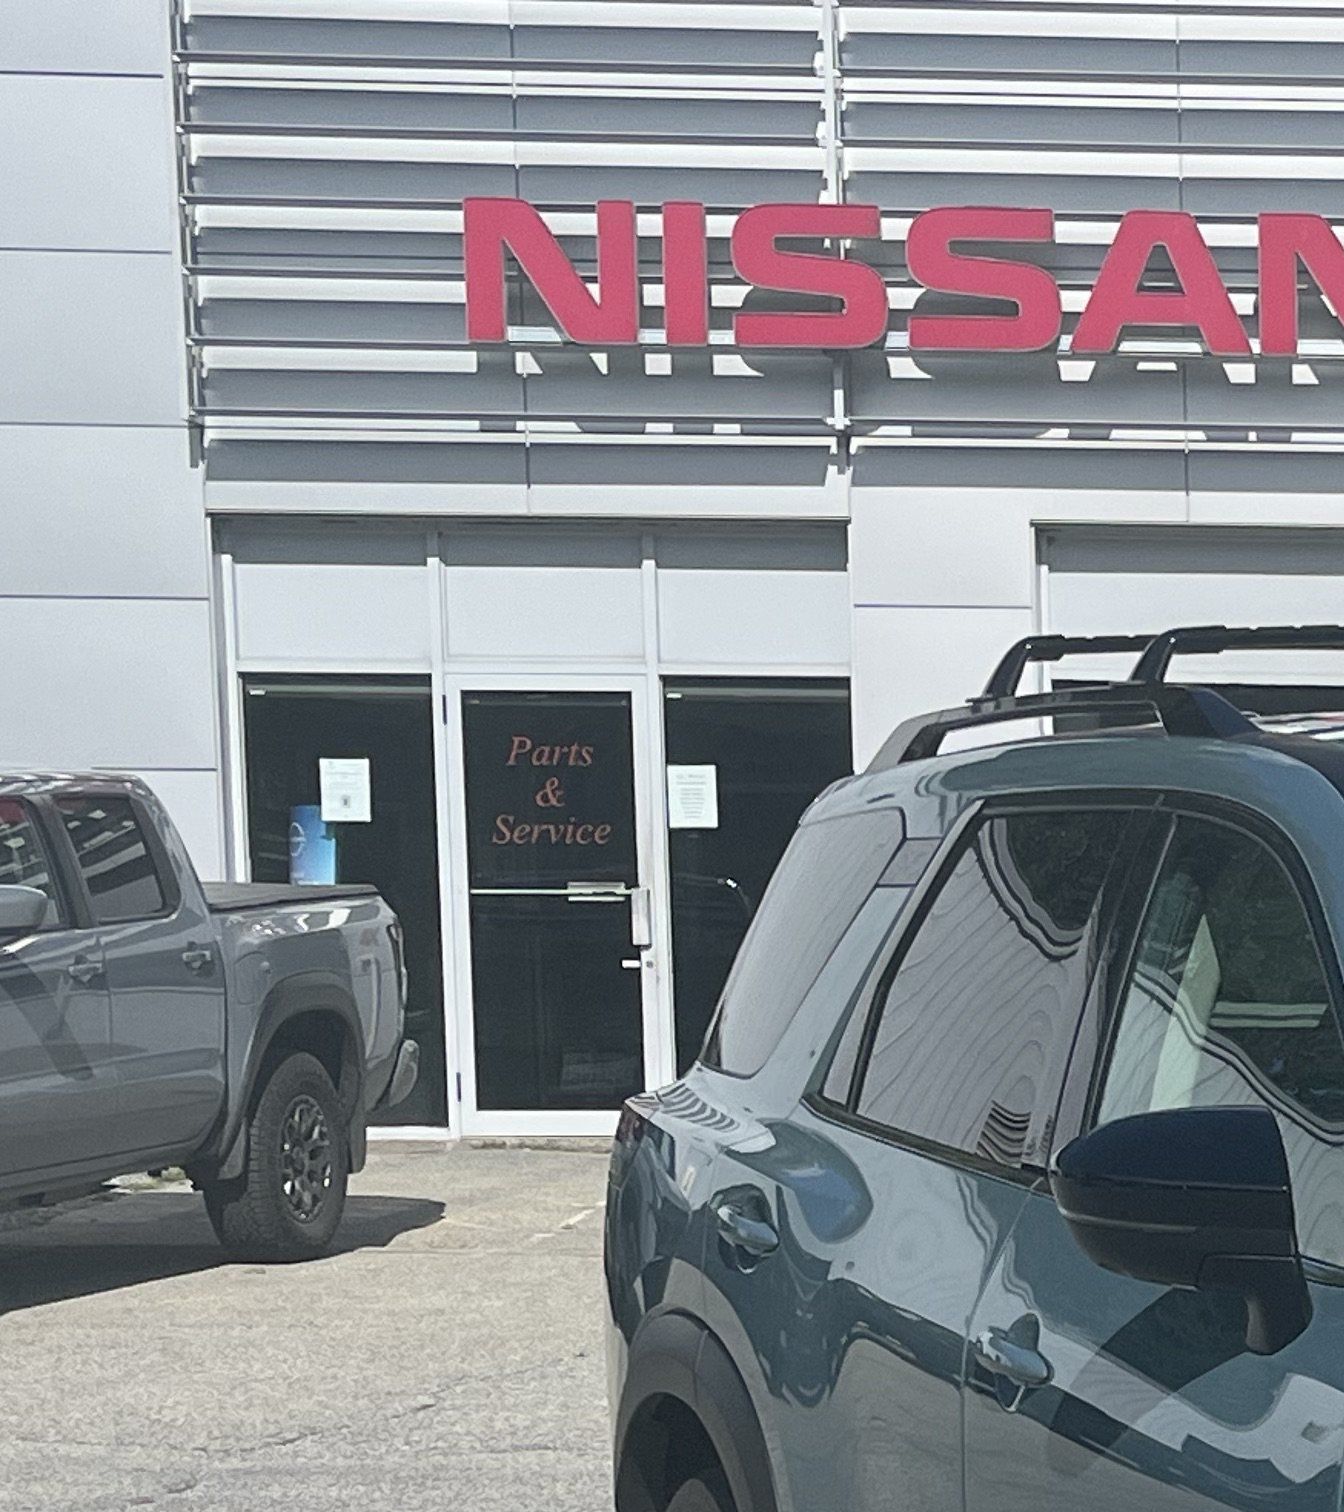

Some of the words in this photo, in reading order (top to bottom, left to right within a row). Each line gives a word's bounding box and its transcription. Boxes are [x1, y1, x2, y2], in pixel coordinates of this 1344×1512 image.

[506, 736, 594, 766] Parts
[535, 776, 566, 808] &
[492, 814, 612, 845] Service
